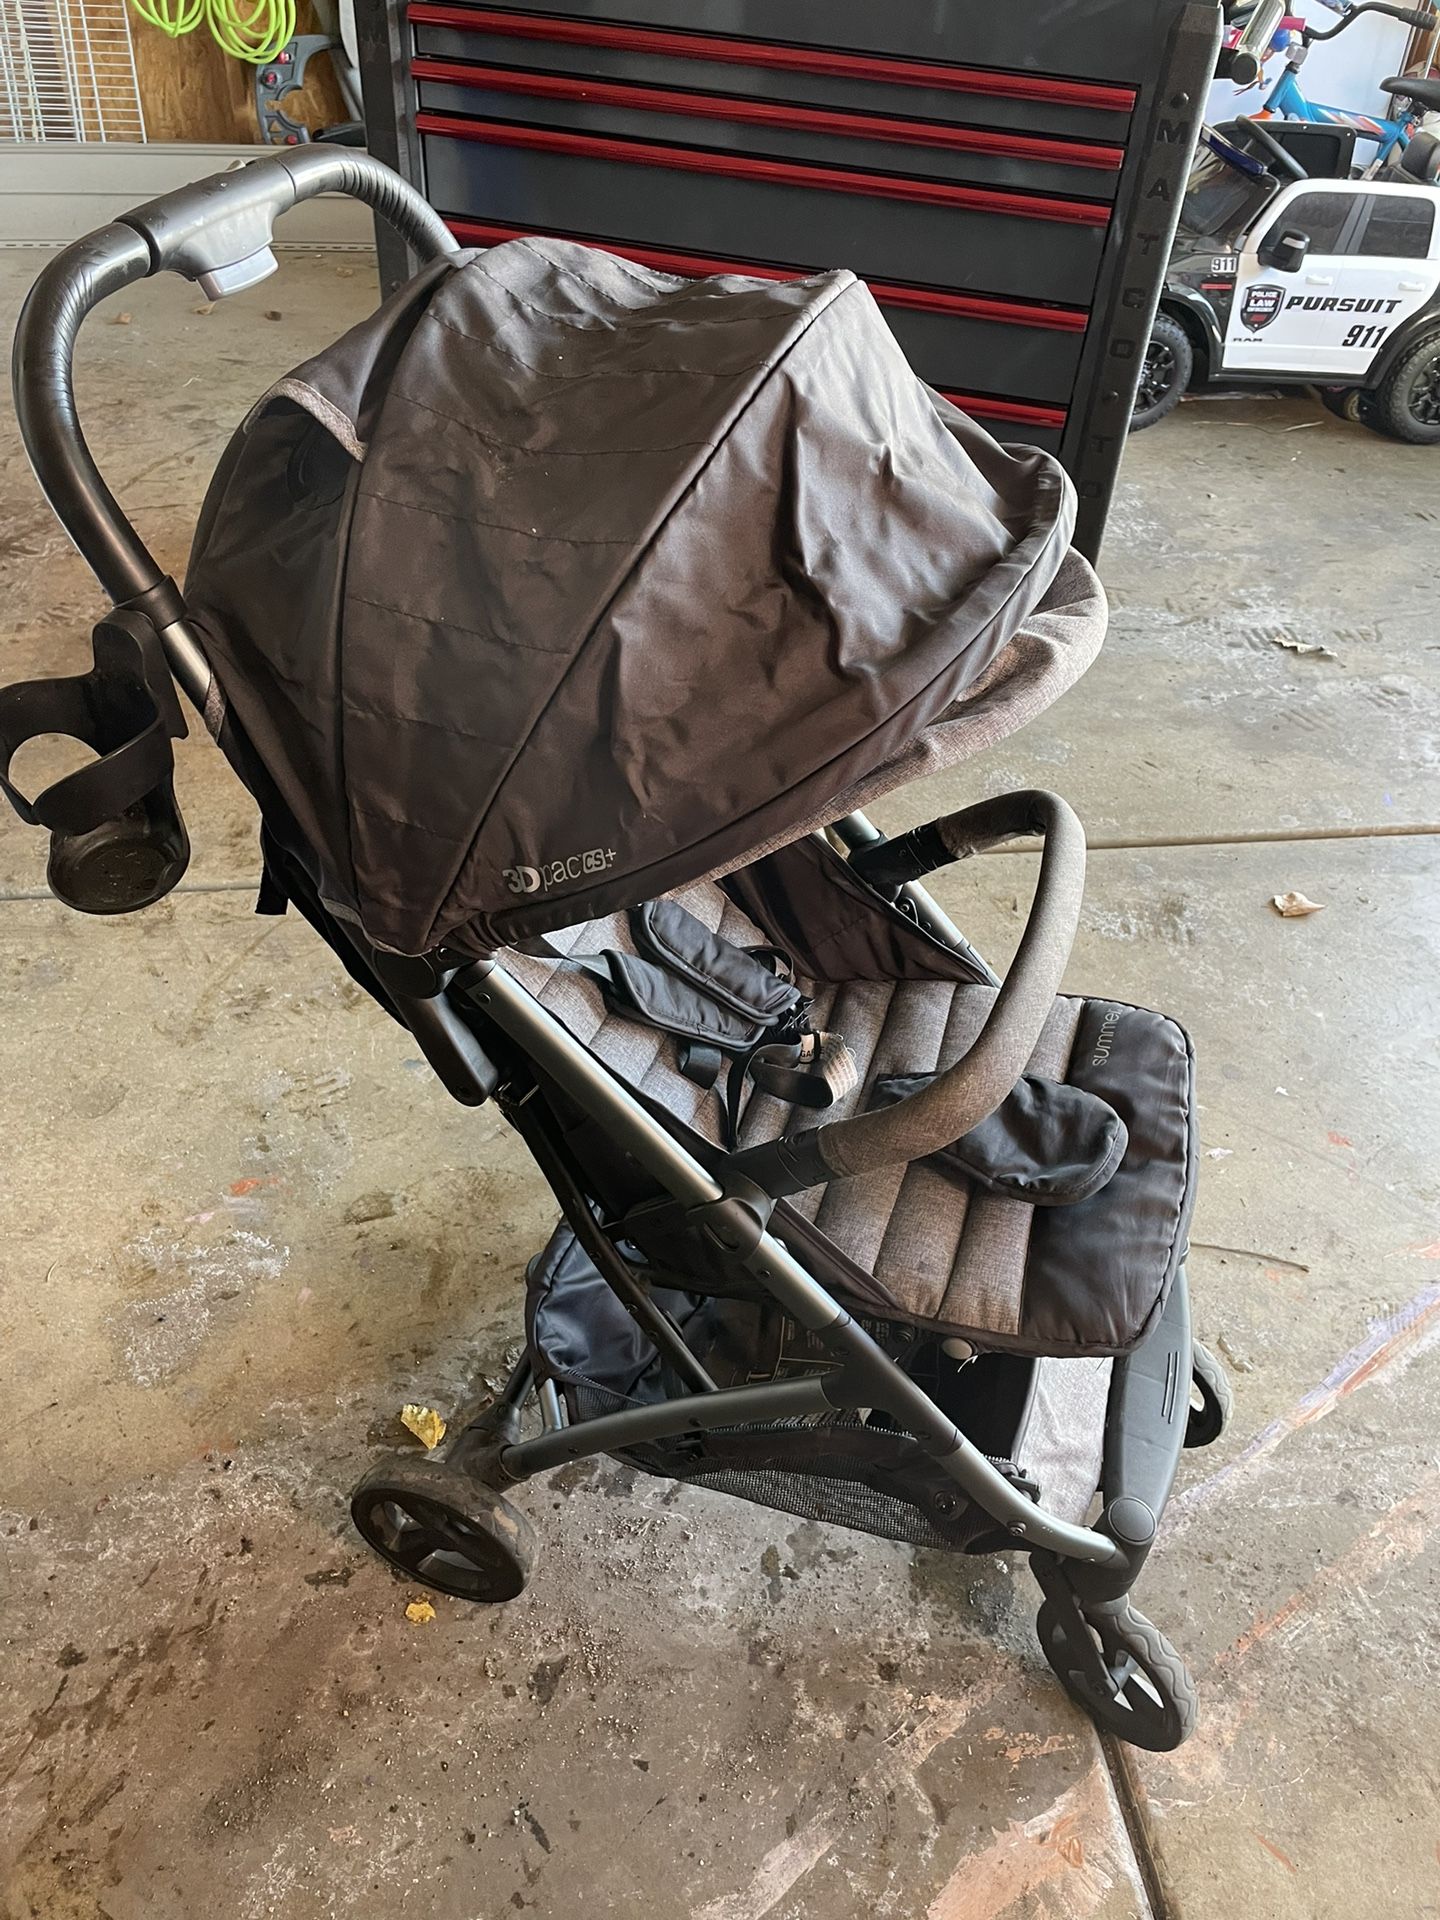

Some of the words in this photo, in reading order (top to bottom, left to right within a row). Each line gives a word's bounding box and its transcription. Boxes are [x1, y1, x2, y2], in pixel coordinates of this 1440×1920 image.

[1109, 118, 1190, 359] MATCO
[1213, 258, 1236, 271] 911
[1249, 299, 1277, 307] LAW
[1285, 296, 1402, 313] PURSUIT
[1342, 324, 1388, 348] 911
[1092, 1009, 1122, 1067] summer
